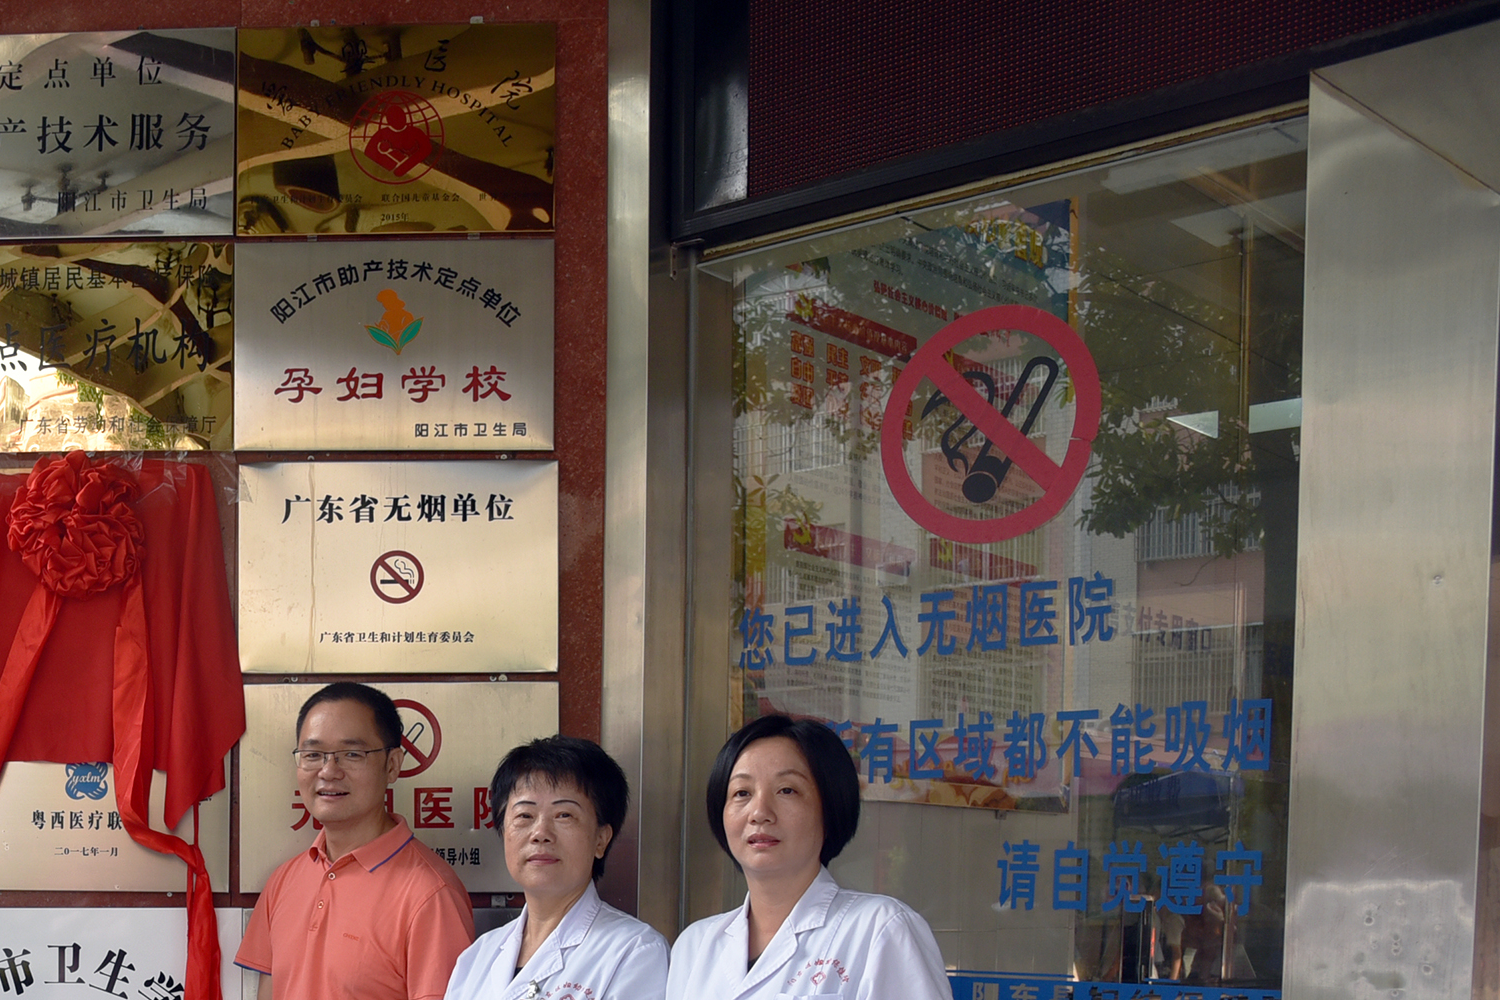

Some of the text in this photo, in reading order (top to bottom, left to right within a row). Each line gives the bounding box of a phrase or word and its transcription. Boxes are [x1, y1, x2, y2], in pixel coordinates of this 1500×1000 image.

[280, 75, 517, 150] BABY FRIENDLY HOSPITAL
[57, 187, 208, 213] 阳江市卫生局
[381, 192, 461, 204] 联合国儿童基金会
[380, 212, 409, 223] 2015年
[269, 258, 522, 328] 阳江市助产技术定点单位
[827, 343, 850, 370] 民主
[274, 365, 512, 403] 孕妇学校
[790, 357, 815, 384] 自由
[414, 422, 528, 438] 阳江市卫生局
[281, 493, 515, 524] 广东省无烟单位
[738, 571, 1115, 671] 您已进入无烟医院
[319, 631, 475, 644] 广东省卫生和计划生育委员会
[997, 839, 1264, 916] 请自觉遵守
